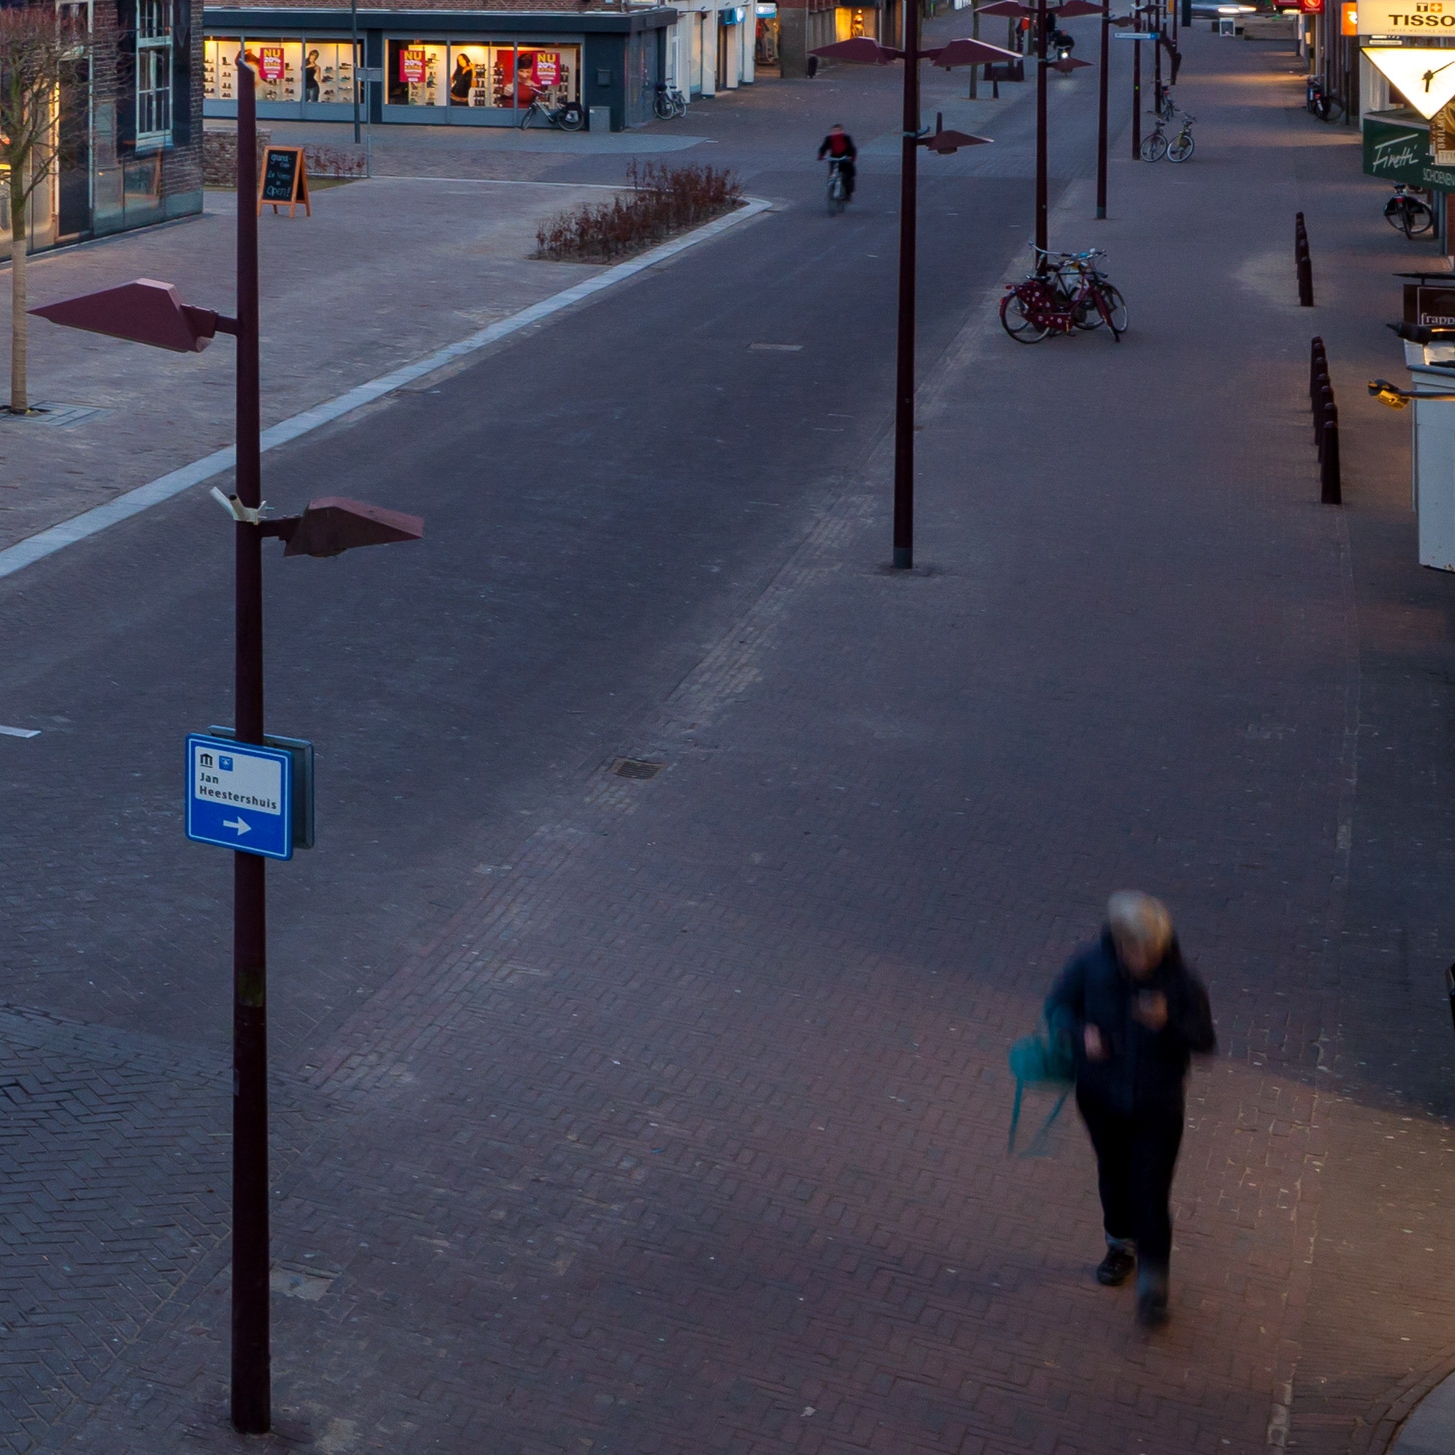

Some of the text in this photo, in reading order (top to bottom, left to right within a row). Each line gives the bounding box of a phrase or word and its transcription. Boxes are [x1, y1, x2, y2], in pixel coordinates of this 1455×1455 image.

[1388, 14, 1455, 26] TISSO
[264, 49, 281, 57] NU
[404, 51, 422, 60] NU
[537, 53, 556, 62] NU
[200, 772, 219, 784] Jan
[199, 785, 277, 809] Heestershuis
